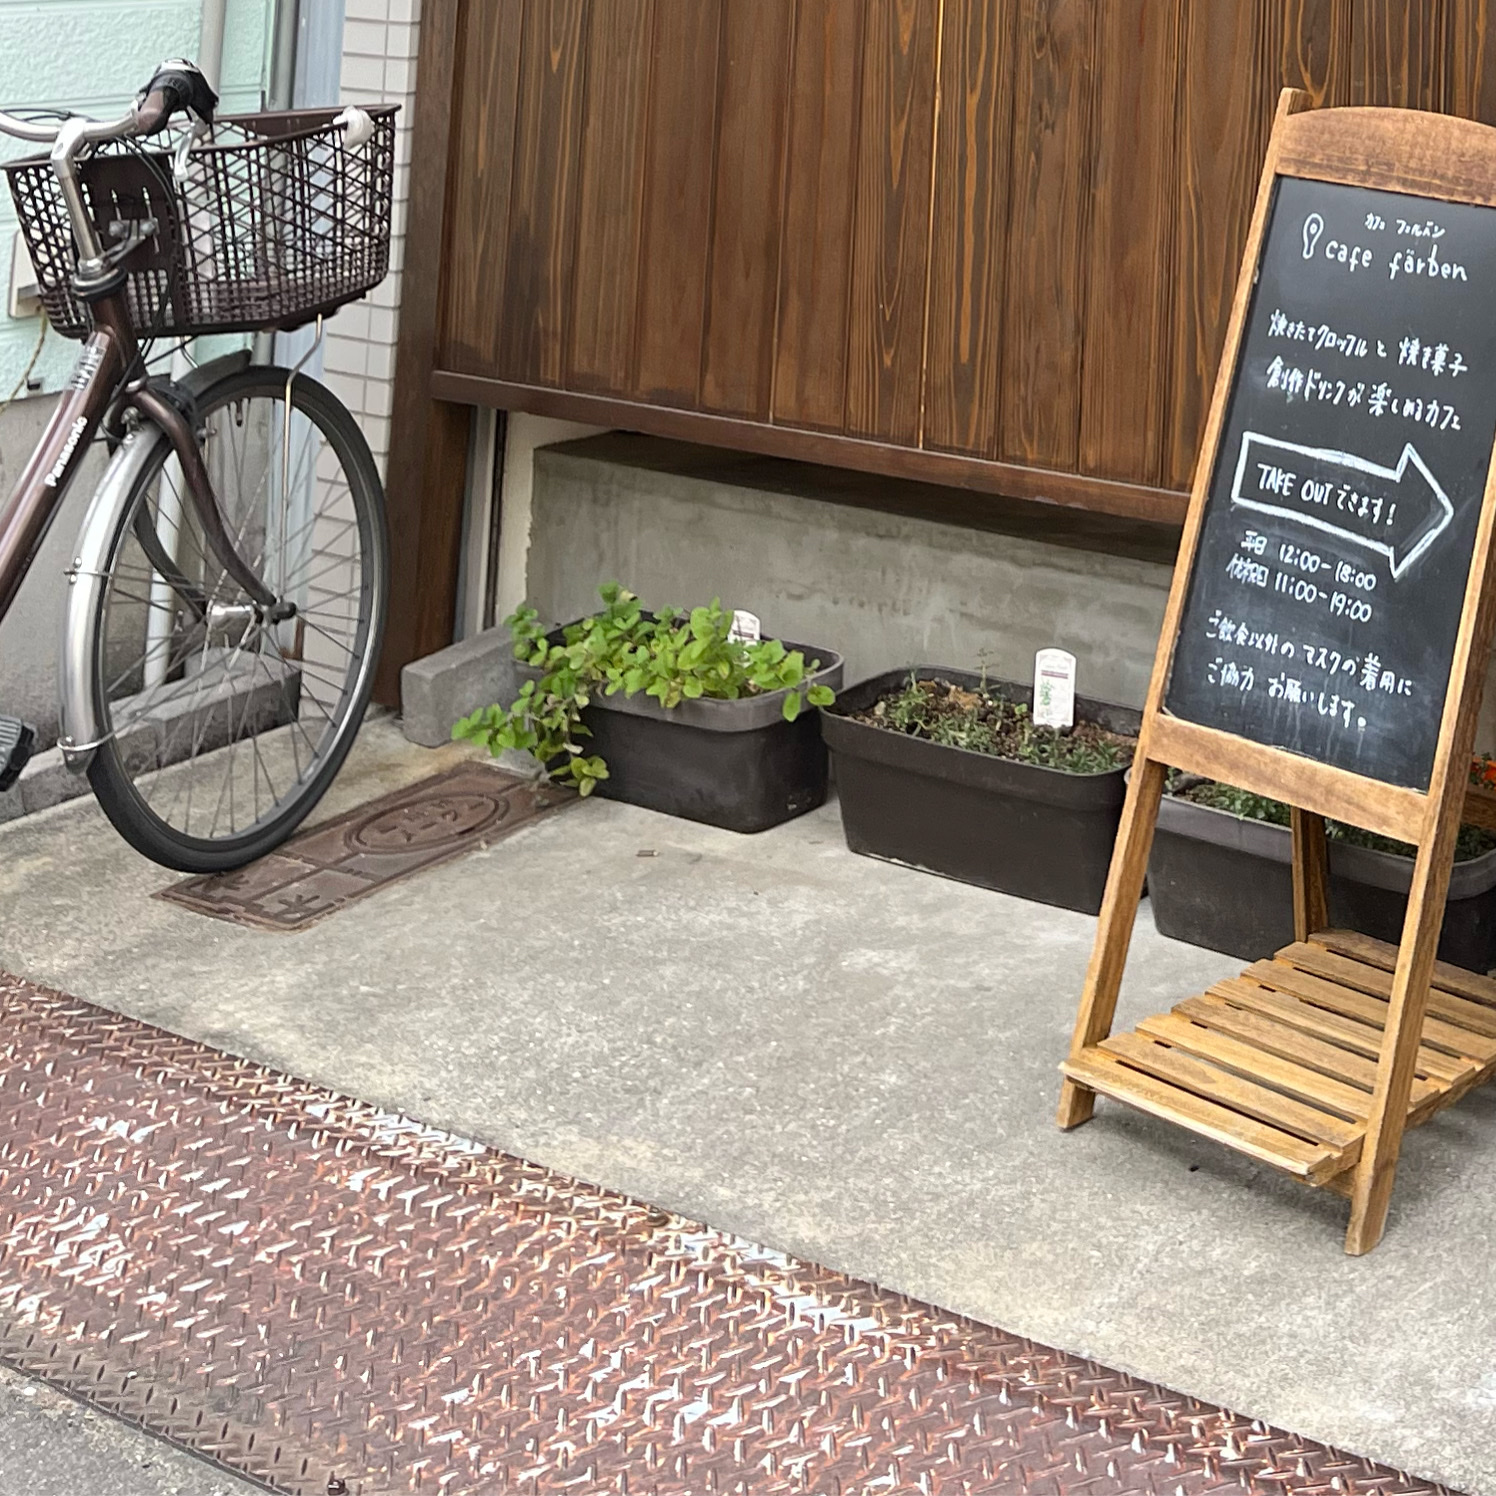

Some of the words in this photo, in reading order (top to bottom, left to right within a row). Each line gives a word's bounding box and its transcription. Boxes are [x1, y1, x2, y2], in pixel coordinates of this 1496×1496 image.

[1325, 240, 1373, 272] cafe
[1389, 244, 1468, 281] färben
[44, 415, 88, 488] Panasonic
[1257, 463, 1297, 497] TAKE
[1240, 530, 1268, 556] 平日
